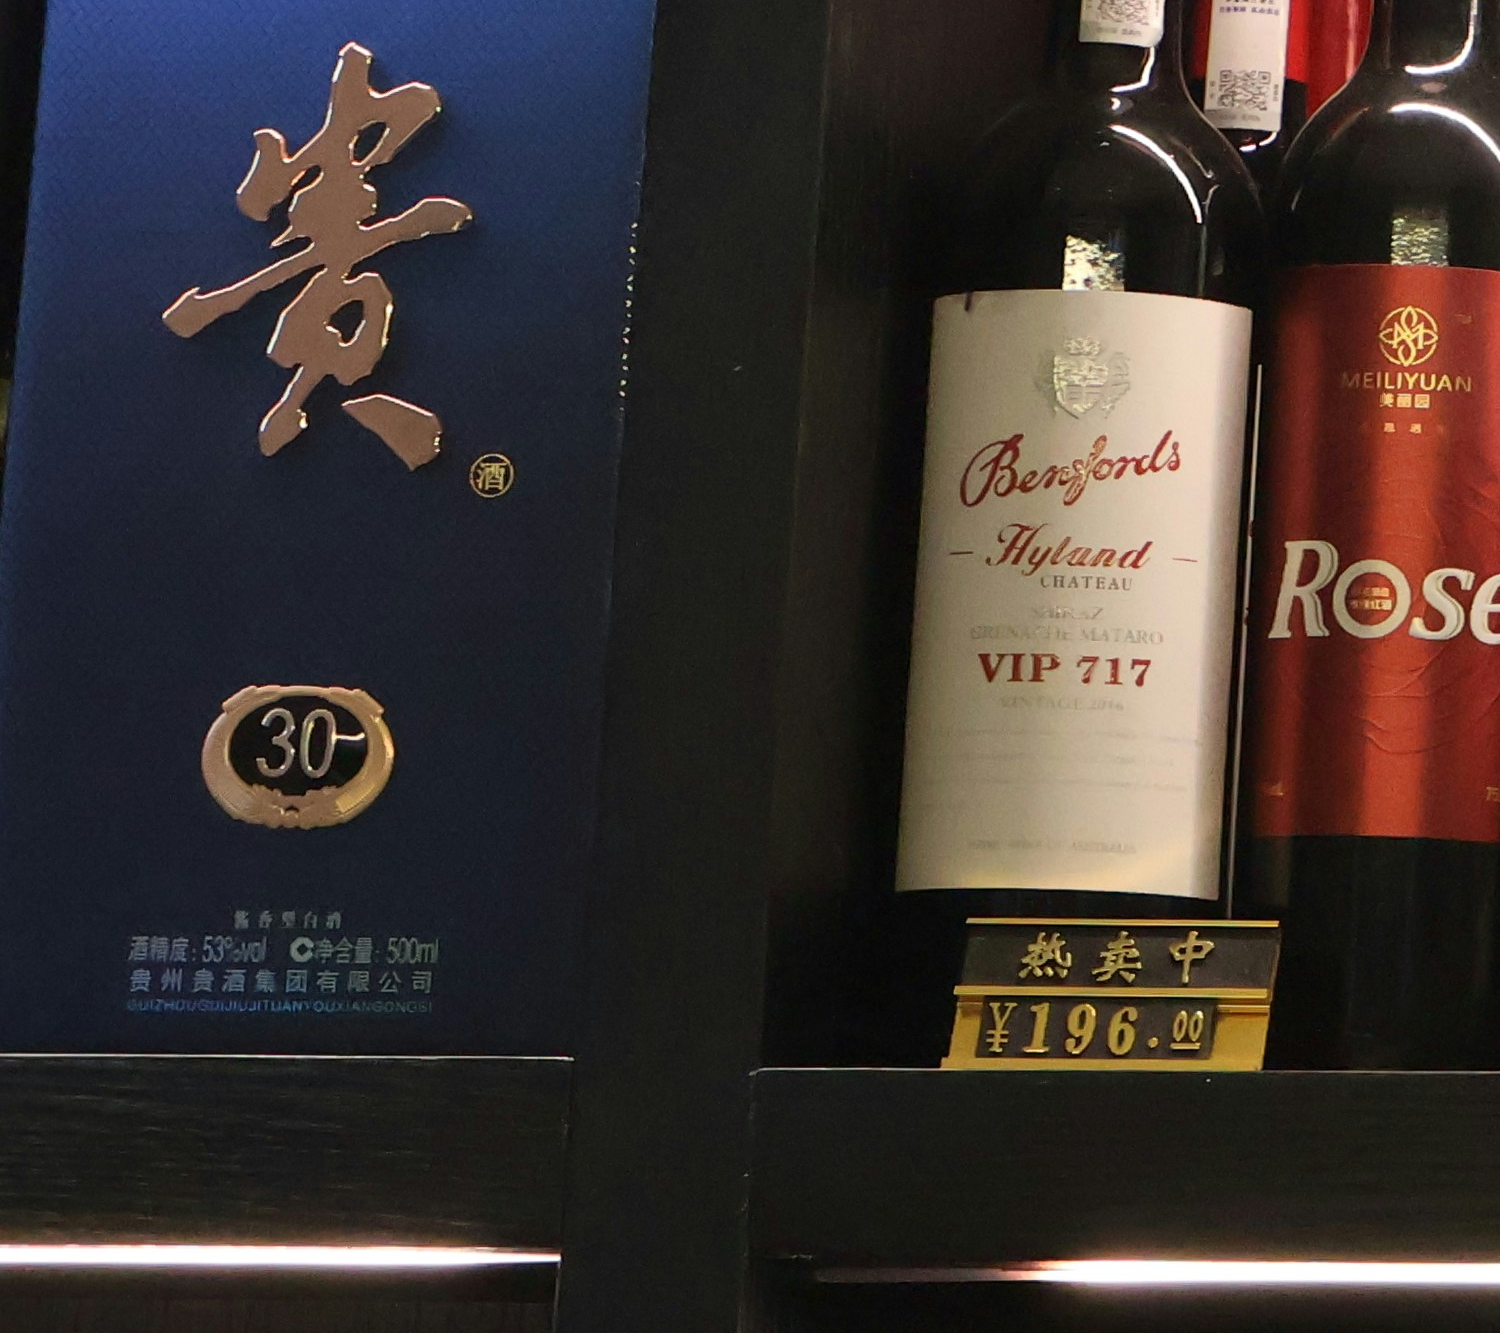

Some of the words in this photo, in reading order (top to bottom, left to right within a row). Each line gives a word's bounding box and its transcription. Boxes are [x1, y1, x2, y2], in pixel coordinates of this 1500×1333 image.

[1341, 371, 1472, 393] MEILIYUAN
[1379, 394, 1430, 409] 美丽园
[472, 458, 510, 494] 酒
[985, 523, 1154, 576] Hyland
[1040, 575, 1133, 591] CHATEAU
[977, 653, 1061, 683] VIP
[1077, 656, 1151, 687] 717
[256, 708, 337, 778] 30
[1018, 931, 1214, 984] 热卖中
[129, 969, 434, 994] 贵州贵酒集团有限公司
[985, 1003, 1204, 1056] ¥196.00
